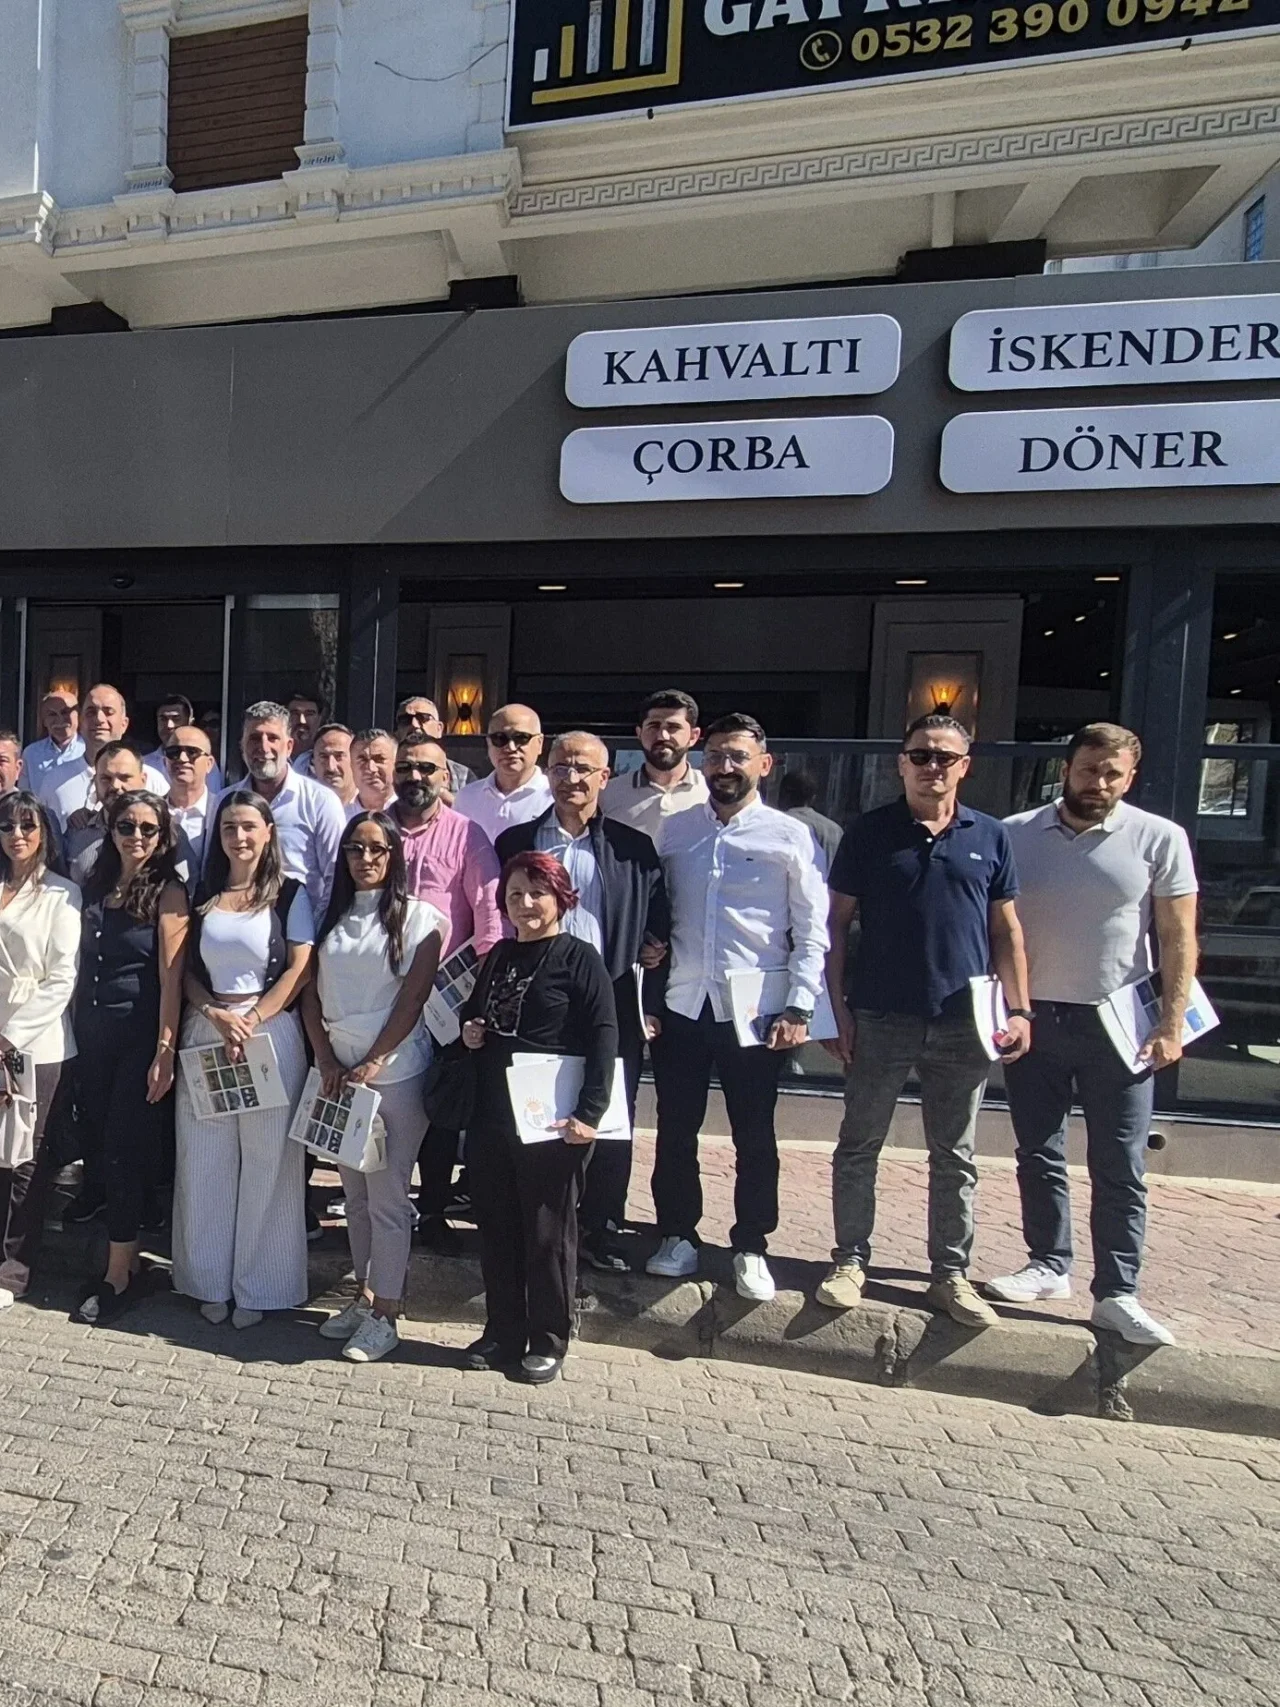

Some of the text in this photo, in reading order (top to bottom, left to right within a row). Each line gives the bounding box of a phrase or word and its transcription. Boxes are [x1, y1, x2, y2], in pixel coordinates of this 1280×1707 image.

[851, 14, 973, 61] 0532
[989, 0, 1088, 44] 390
[1106, 0, 1249, 27] 09
[602, 337, 862, 386] KAHVALTI
[987, 321, 1280, 374] İSKENDER
[632, 434, 810, 485] ÇORBA
[1017, 425, 1228, 473] DÖNER
